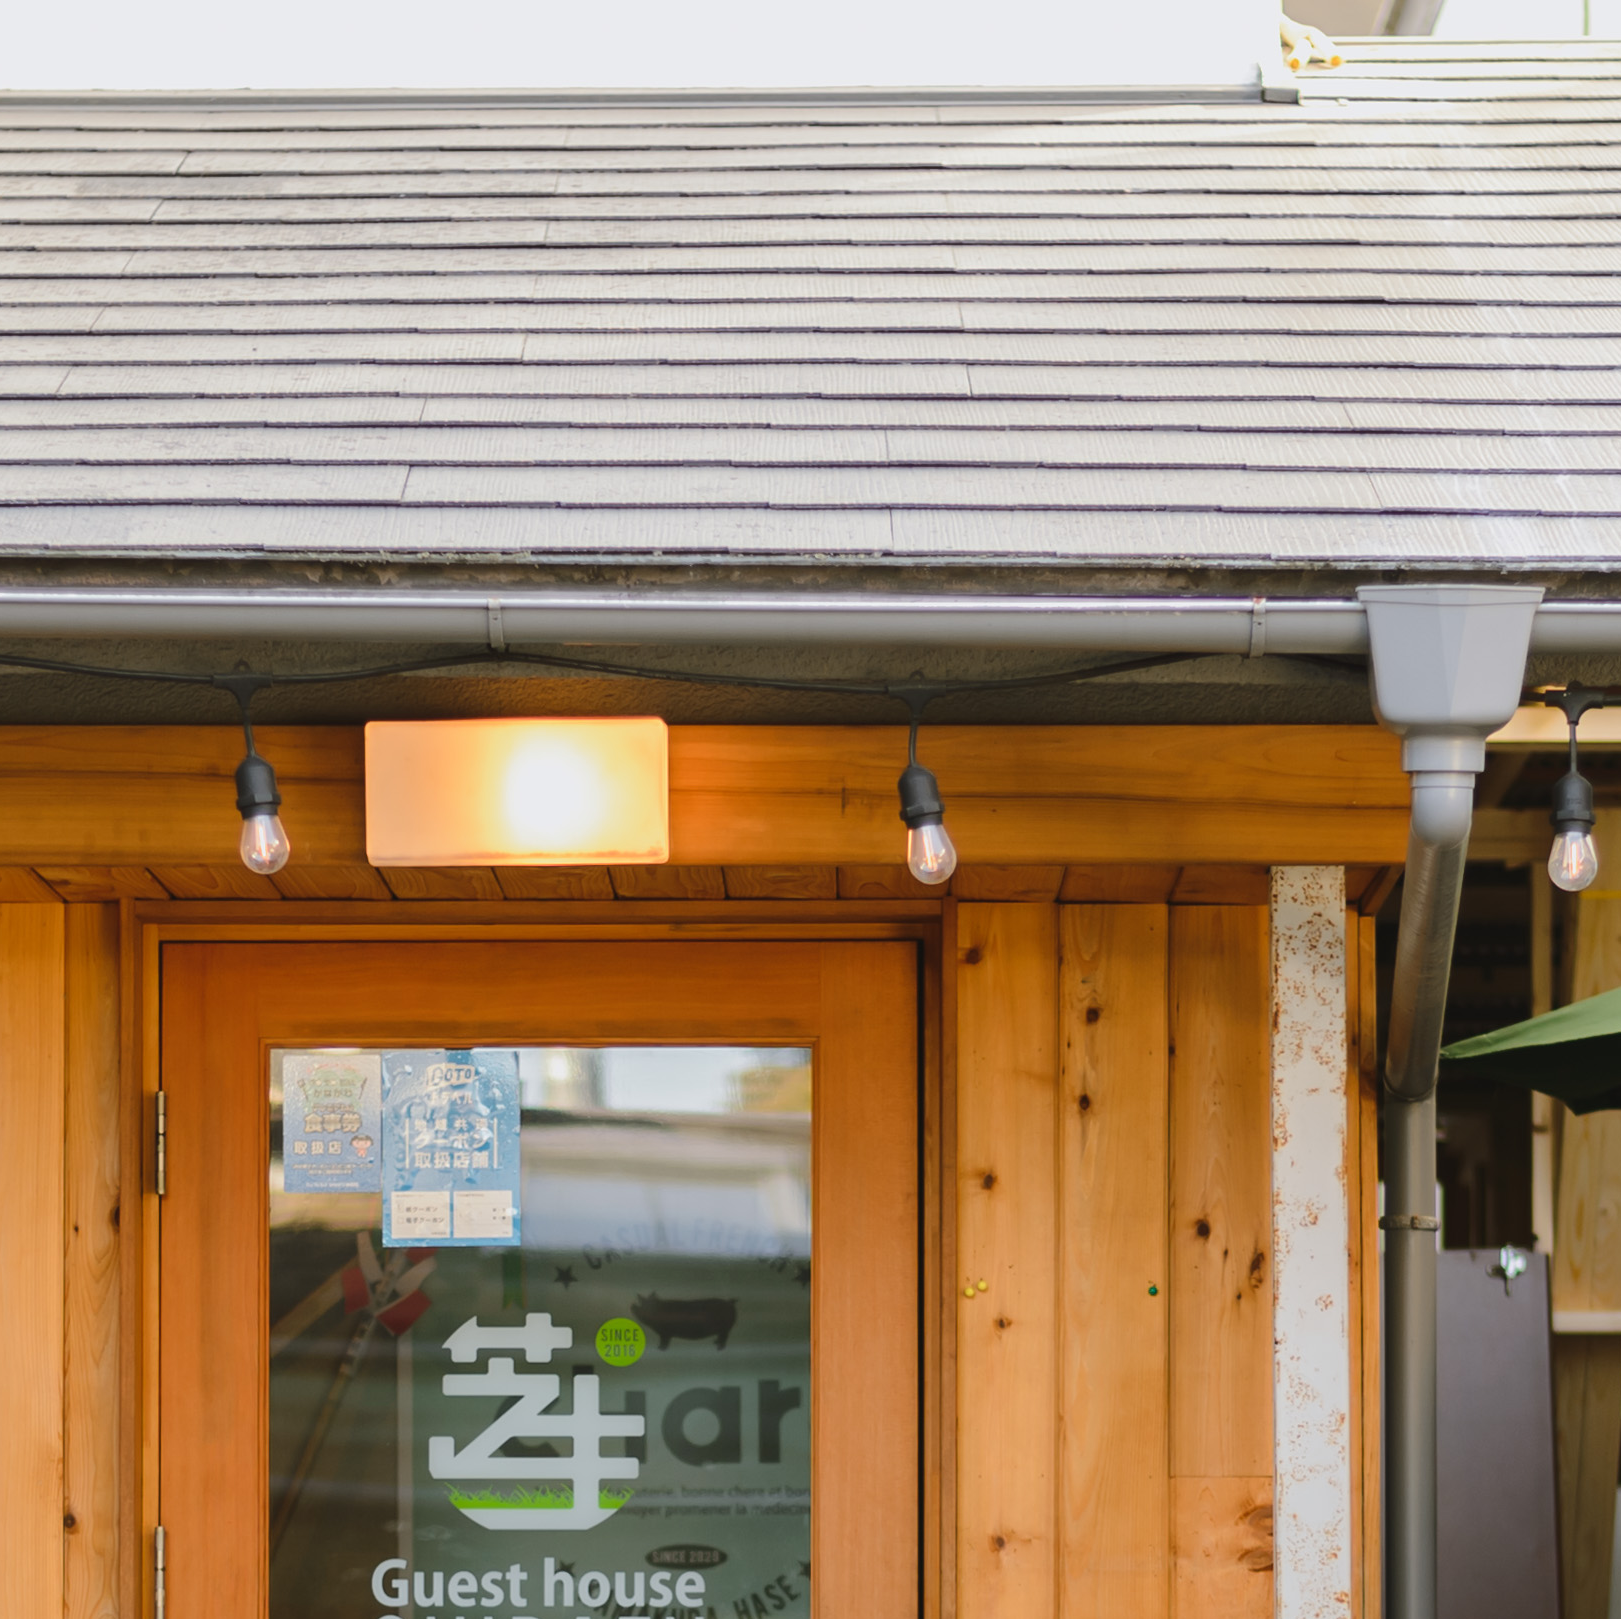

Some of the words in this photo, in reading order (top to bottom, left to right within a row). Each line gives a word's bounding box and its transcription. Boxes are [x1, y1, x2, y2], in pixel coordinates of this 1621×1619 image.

[304, 1113, 362, 1133] 食事券
[293, 1140, 342, 1155] 取扱店
[414, 1152, 489, 1169] 取扱店舗
[601, 1328, 640, 1343] SINCE
[604, 1344, 636, 1358] 2016
[652, 1550, 686, 1563] SINCE
[371, 1559, 528, 1607] Guest
[543, 1557, 707, 1608] house
